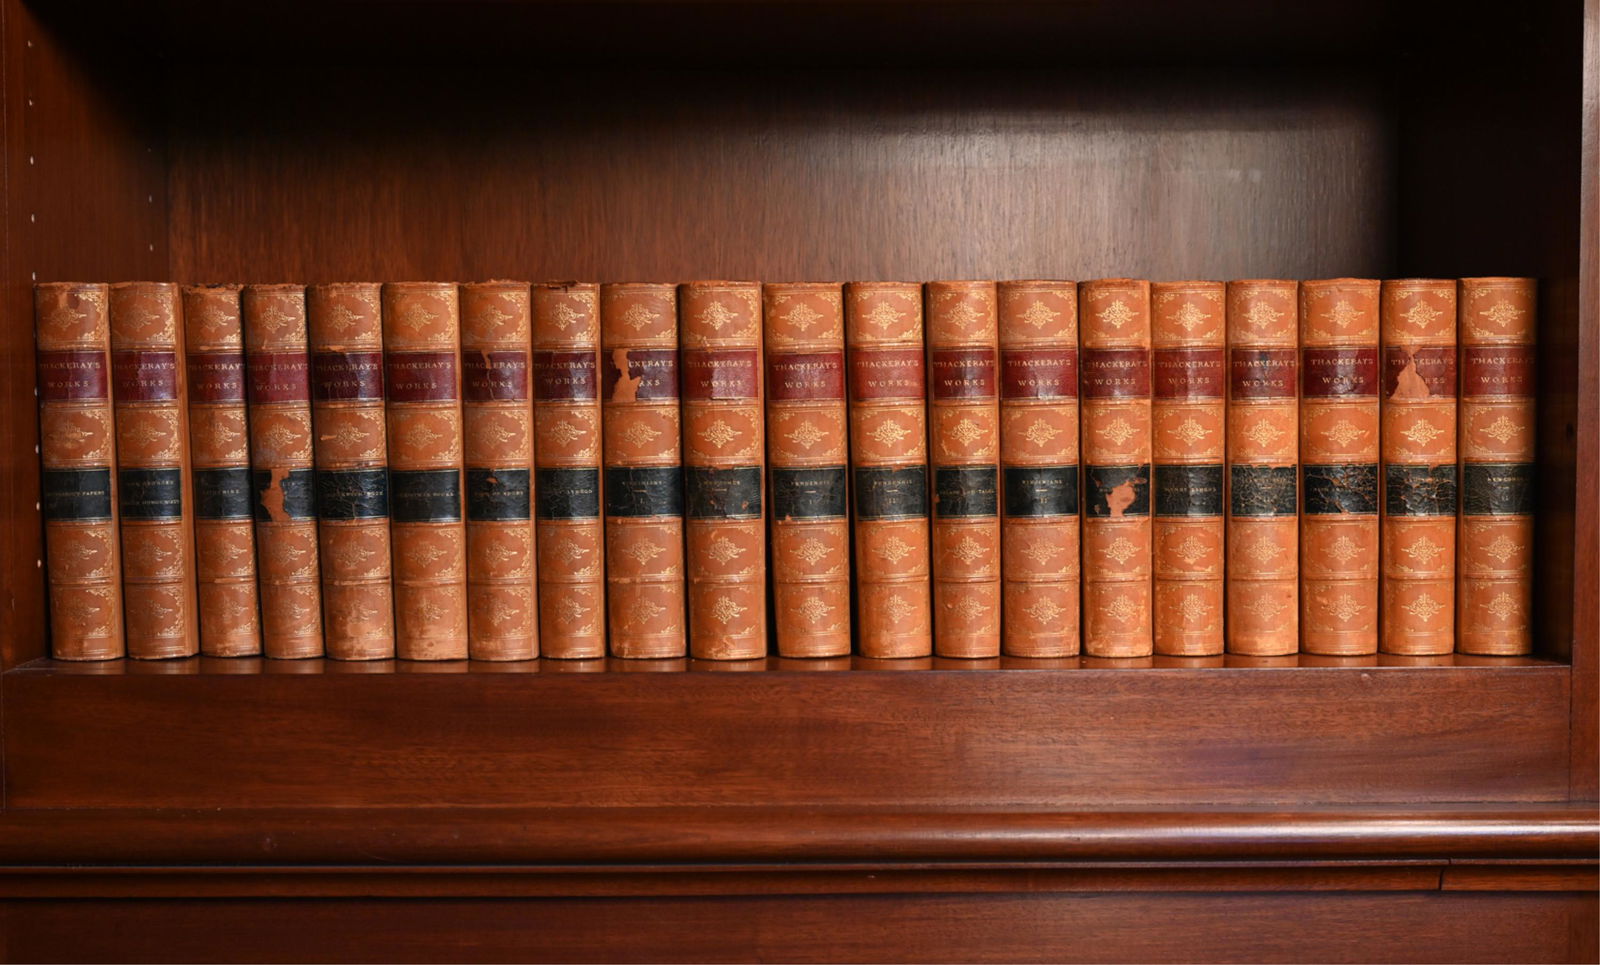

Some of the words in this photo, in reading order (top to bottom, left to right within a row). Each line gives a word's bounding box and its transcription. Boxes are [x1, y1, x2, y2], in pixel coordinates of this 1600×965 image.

[856, 360, 920, 368] THACKERAY'S
[545, 377, 586, 386] WORKS
[867, 380, 910, 388] WORKS
[944, 379, 986, 387] WORKS
[1018, 379, 1060, 387] WORKS
[1168, 376, 1210, 385] WORKS
[396, 382, 437, 390] WORKS
